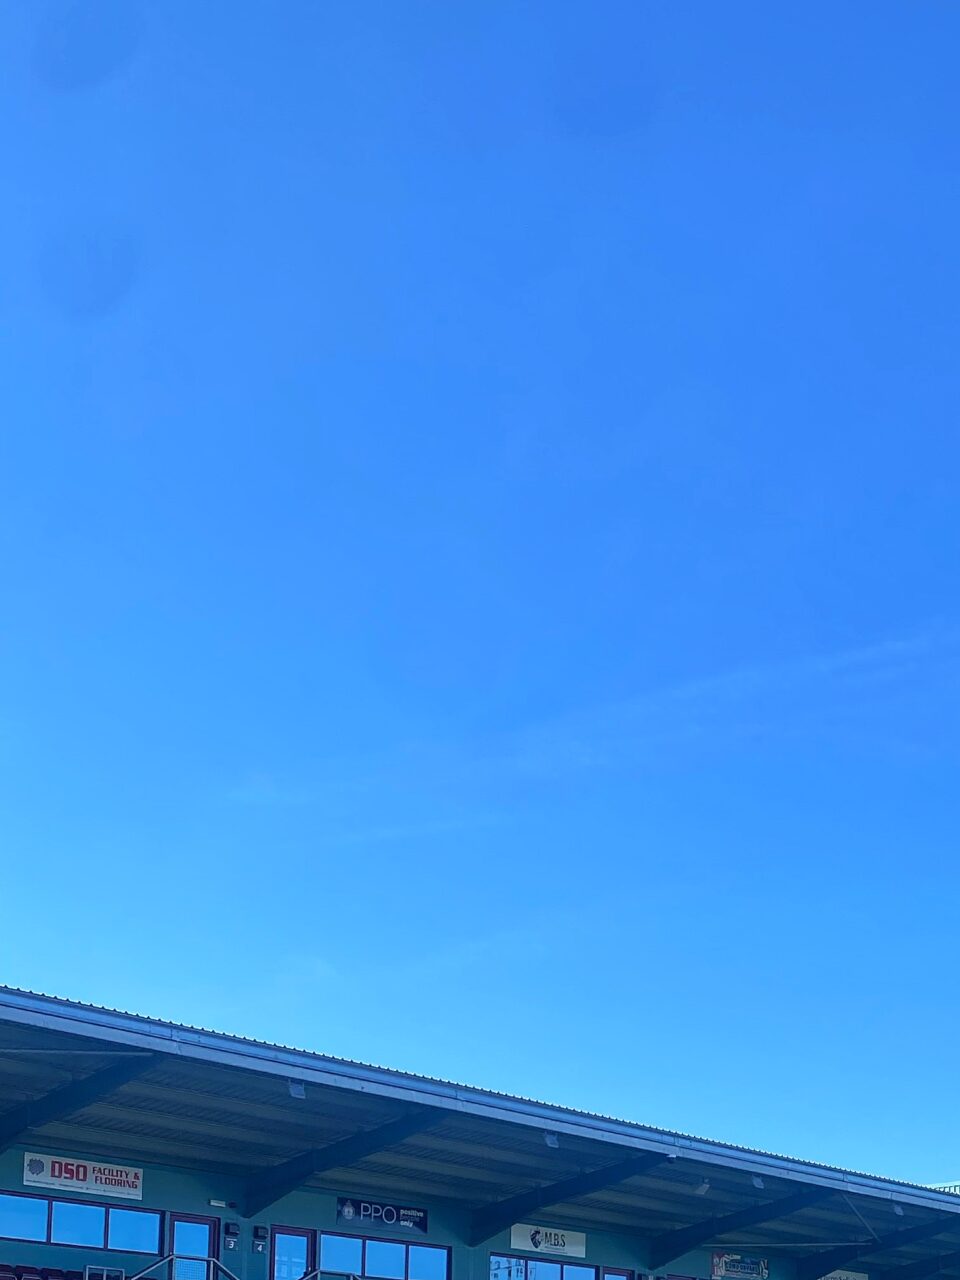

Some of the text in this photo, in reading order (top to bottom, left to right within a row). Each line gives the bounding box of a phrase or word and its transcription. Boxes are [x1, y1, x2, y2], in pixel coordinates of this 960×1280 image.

[50, 1160, 140, 1182] DSO FACILITY &
[95, 1176, 138, 1189] FLOORING
[360, 1203, 397, 1224] PPO
[228, 1241, 234, 1249] 3
